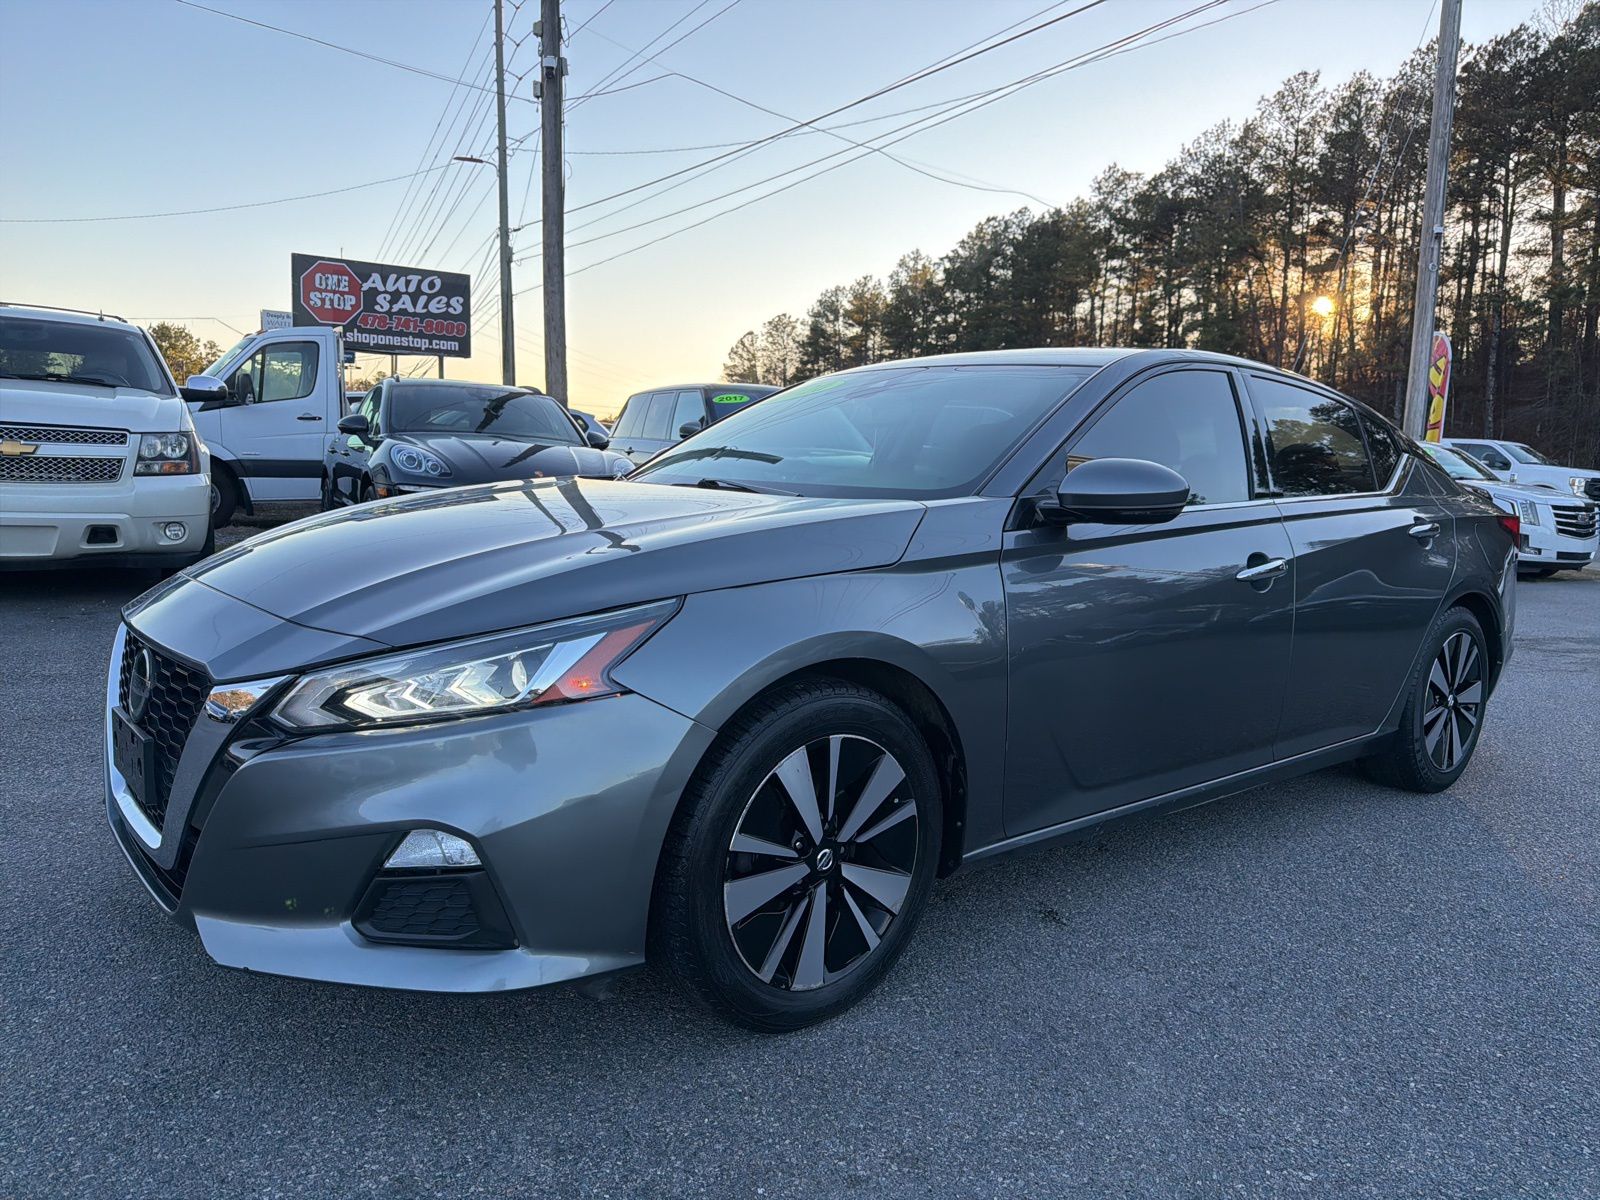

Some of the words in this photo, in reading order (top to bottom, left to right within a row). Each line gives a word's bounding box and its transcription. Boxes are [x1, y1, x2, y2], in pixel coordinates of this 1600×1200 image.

[315, 272, 350, 291] ONE
[361, 272, 441, 293] AUTO
[310, 292, 356, 310] STOP
[357, 312, 466, 337] 478-741-8009
